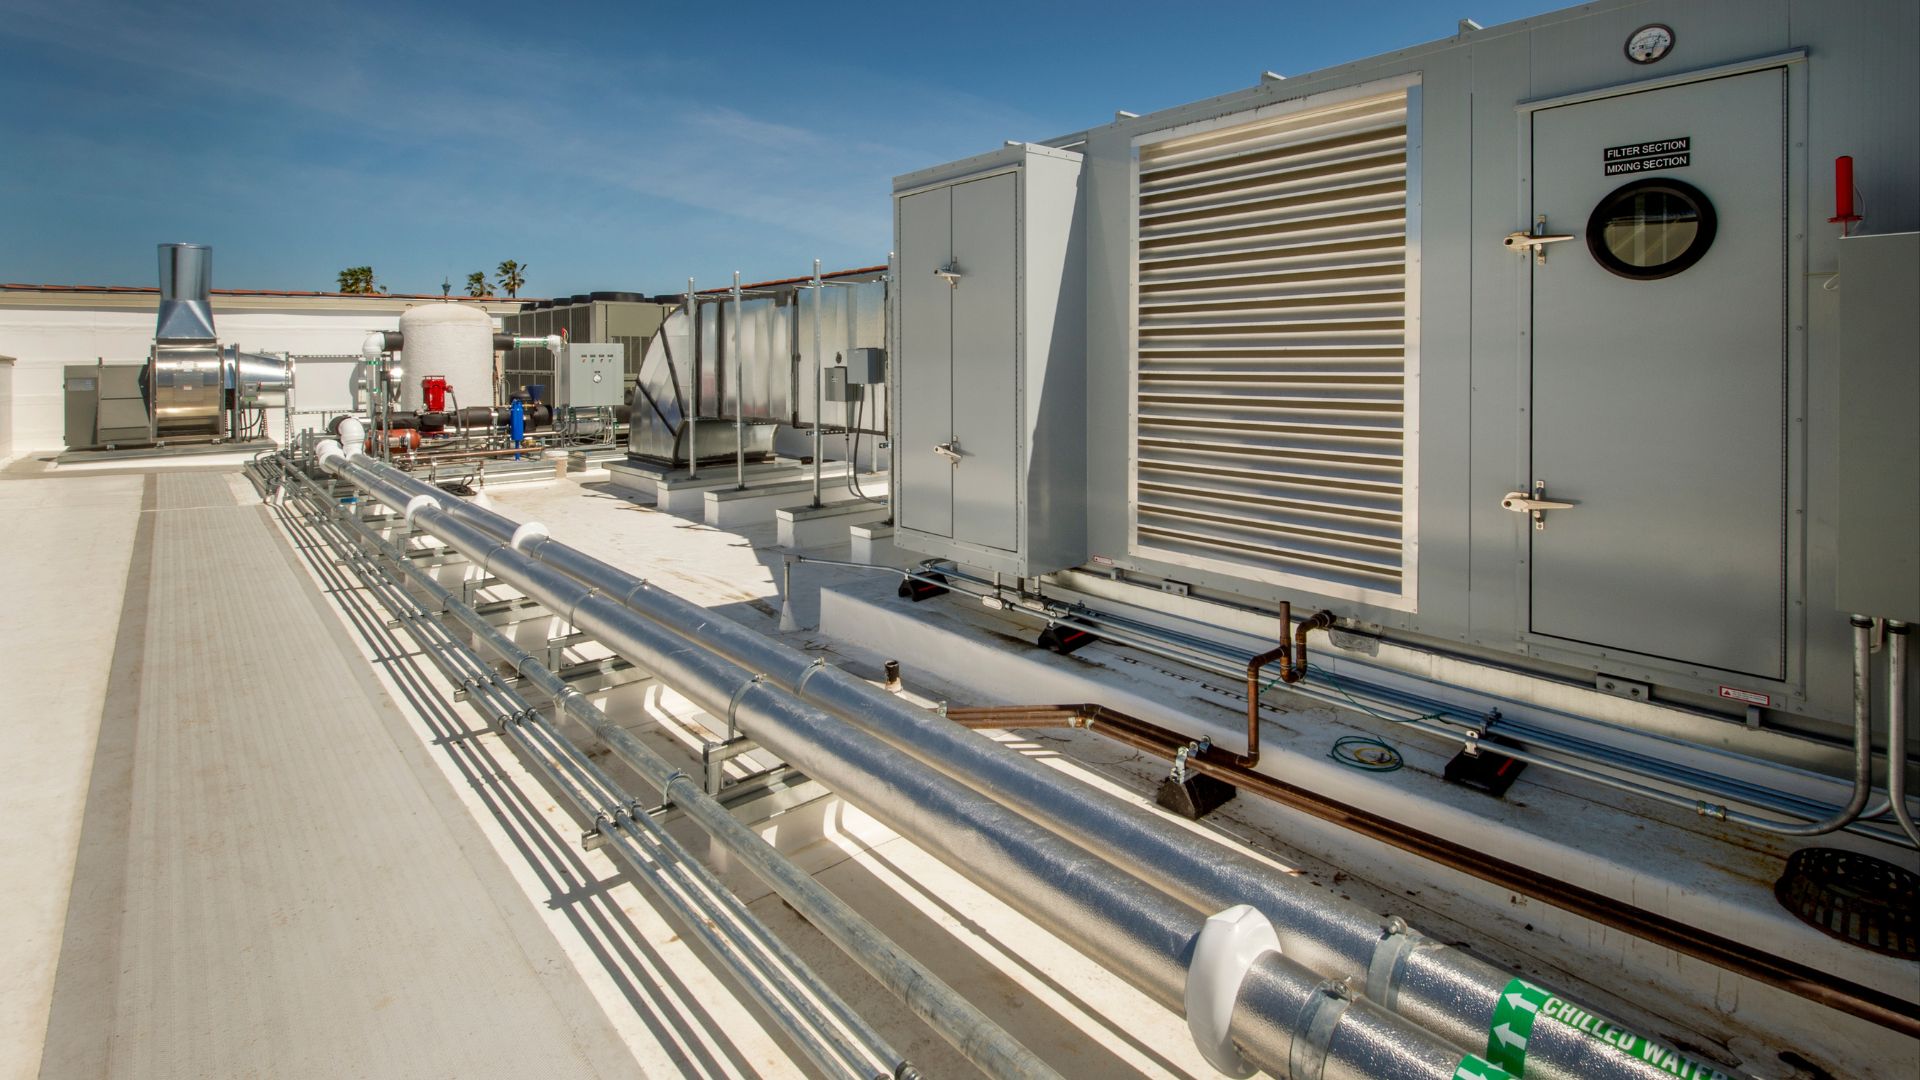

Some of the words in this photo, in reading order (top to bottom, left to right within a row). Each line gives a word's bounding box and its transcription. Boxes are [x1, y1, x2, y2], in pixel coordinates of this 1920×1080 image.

[1607, 146, 1640, 159] FILTER
[1642, 139, 1686, 154] SECTION
[1607, 161, 1641, 174] MIXING
[1642, 156, 1687, 169] SECTION
[1542, 997, 1637, 1051] CHILLED
